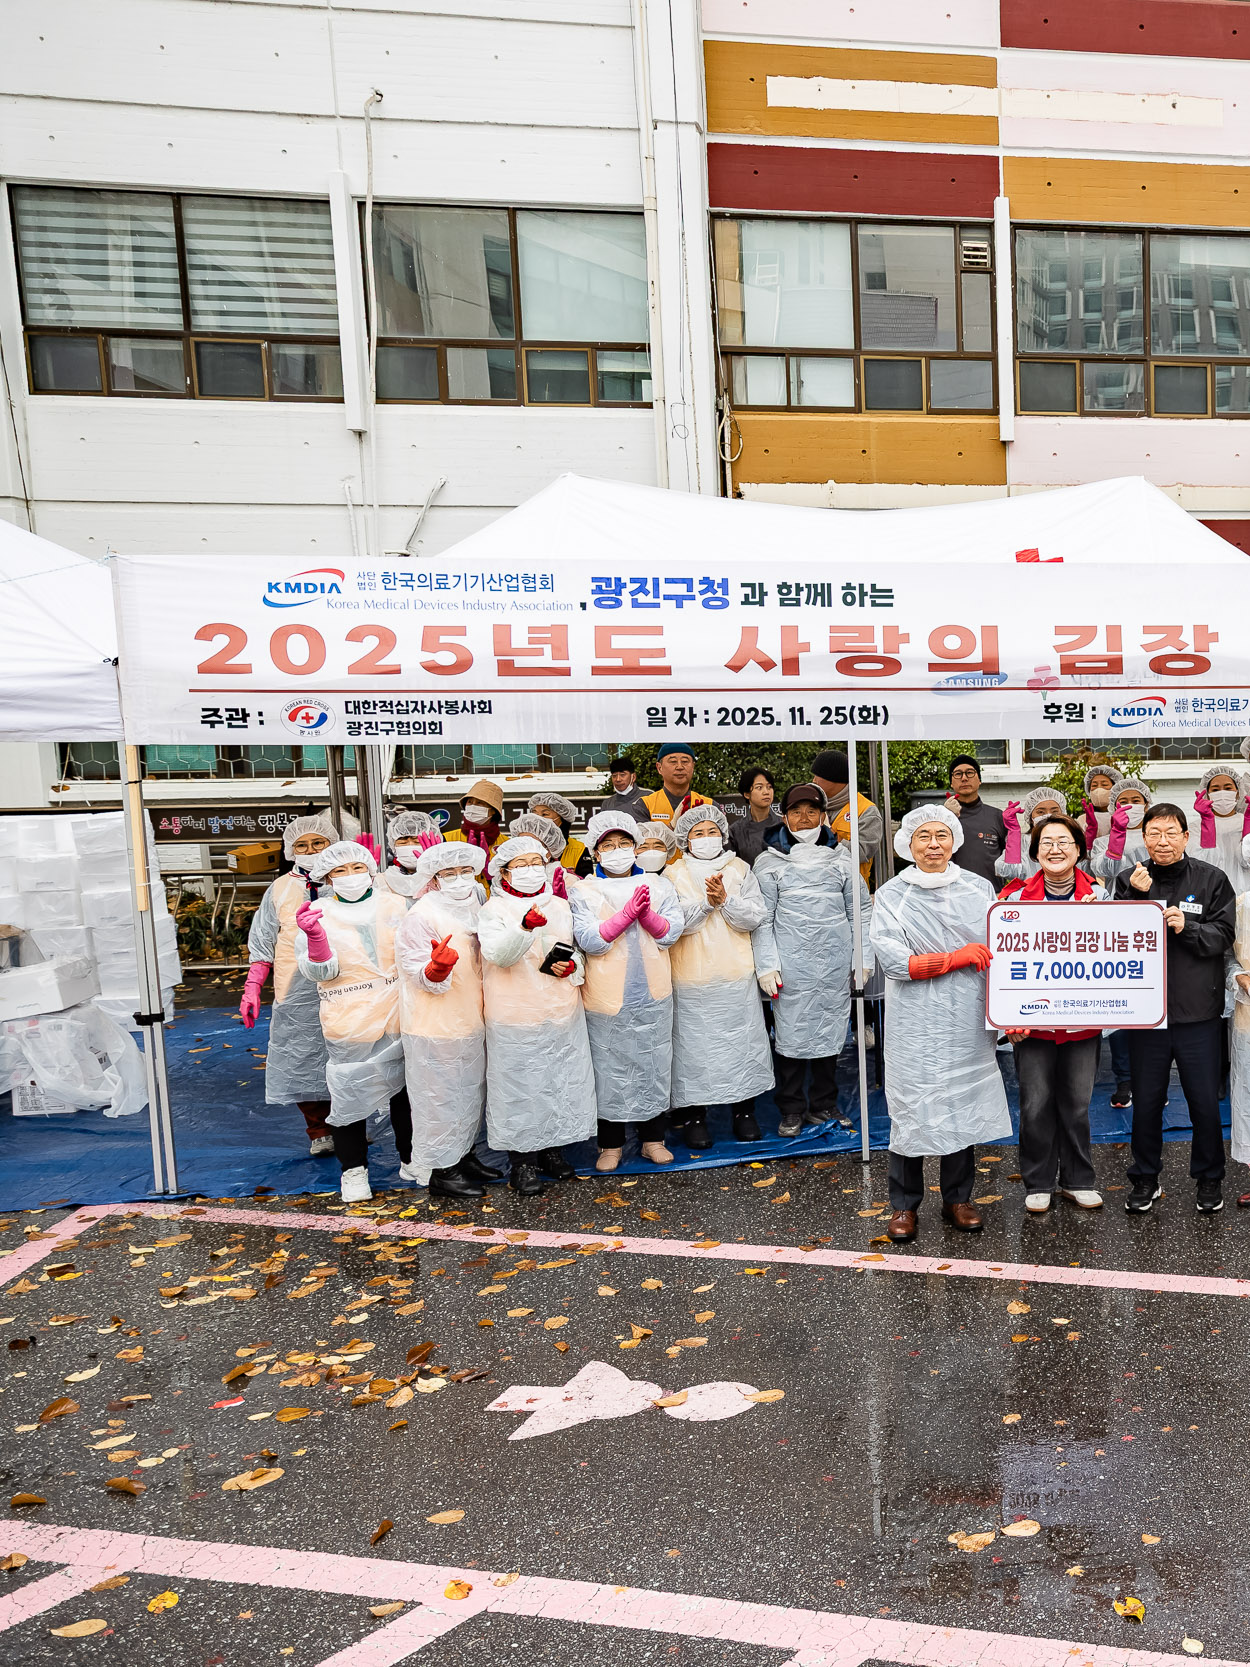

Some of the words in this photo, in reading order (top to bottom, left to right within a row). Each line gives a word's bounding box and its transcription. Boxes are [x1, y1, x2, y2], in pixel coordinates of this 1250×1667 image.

[356, 572, 376, 581] 사단
[381, 572, 554, 592] 한국의료기기산업협회
[267, 582, 342, 594] KMDIA
[357, 581, 377, 591] 법인
[740, 583, 768, 607] 과
[776, 582, 832, 607] 함께
[841, 583, 894, 607] 하는
[327, 599, 360, 610] Korea
[364, 598, 409, 610] Medical
[414, 599, 459, 610] Devices
[462, 600, 506, 613] Industry
[510, 600, 573, 611] Association
[194, 622, 672, 677] 2025년도
[723, 622, 1001, 678] 사랑의
[1053, 622, 1219, 678] 김장
[940, 678, 999, 688] SAMSUNG
[345, 700, 492, 715] 대한적십자사봉사회
[717, 707, 781, 726] 2025.
[789, 706, 812, 726] 11.
[819, 704, 889, 726] 25(화)
[1042, 702, 1084, 723] 후원
[1111, 707, 1163, 717] KMDIA
[200, 708, 250, 729] 주관
[1152, 719, 1176, 728] Korea
[1179, 718, 1211, 728] Medical
[1214, 718, 1246, 727] Devices
[346, 721, 443, 736] 광진구협의회
[159, 815, 206, 834] 소통하며
[208, 815, 256, 834] 발전하는
[996, 932, 1029, 952] 2025
[1033, 931, 1071, 953] 사랑의
[1075, 931, 1100, 953] 김장
[1104, 931, 1129, 953] 나눔
[1132, 930, 1157, 952] 후원
[1010, 961, 1027, 980] 금
[1033, 960, 1144, 981] 7,000,000원
[329, 988, 342, 997] Red
[343, 982, 373, 993] Korean
[1062, 1000, 1128, 1008] 한국의료기기산업협회
